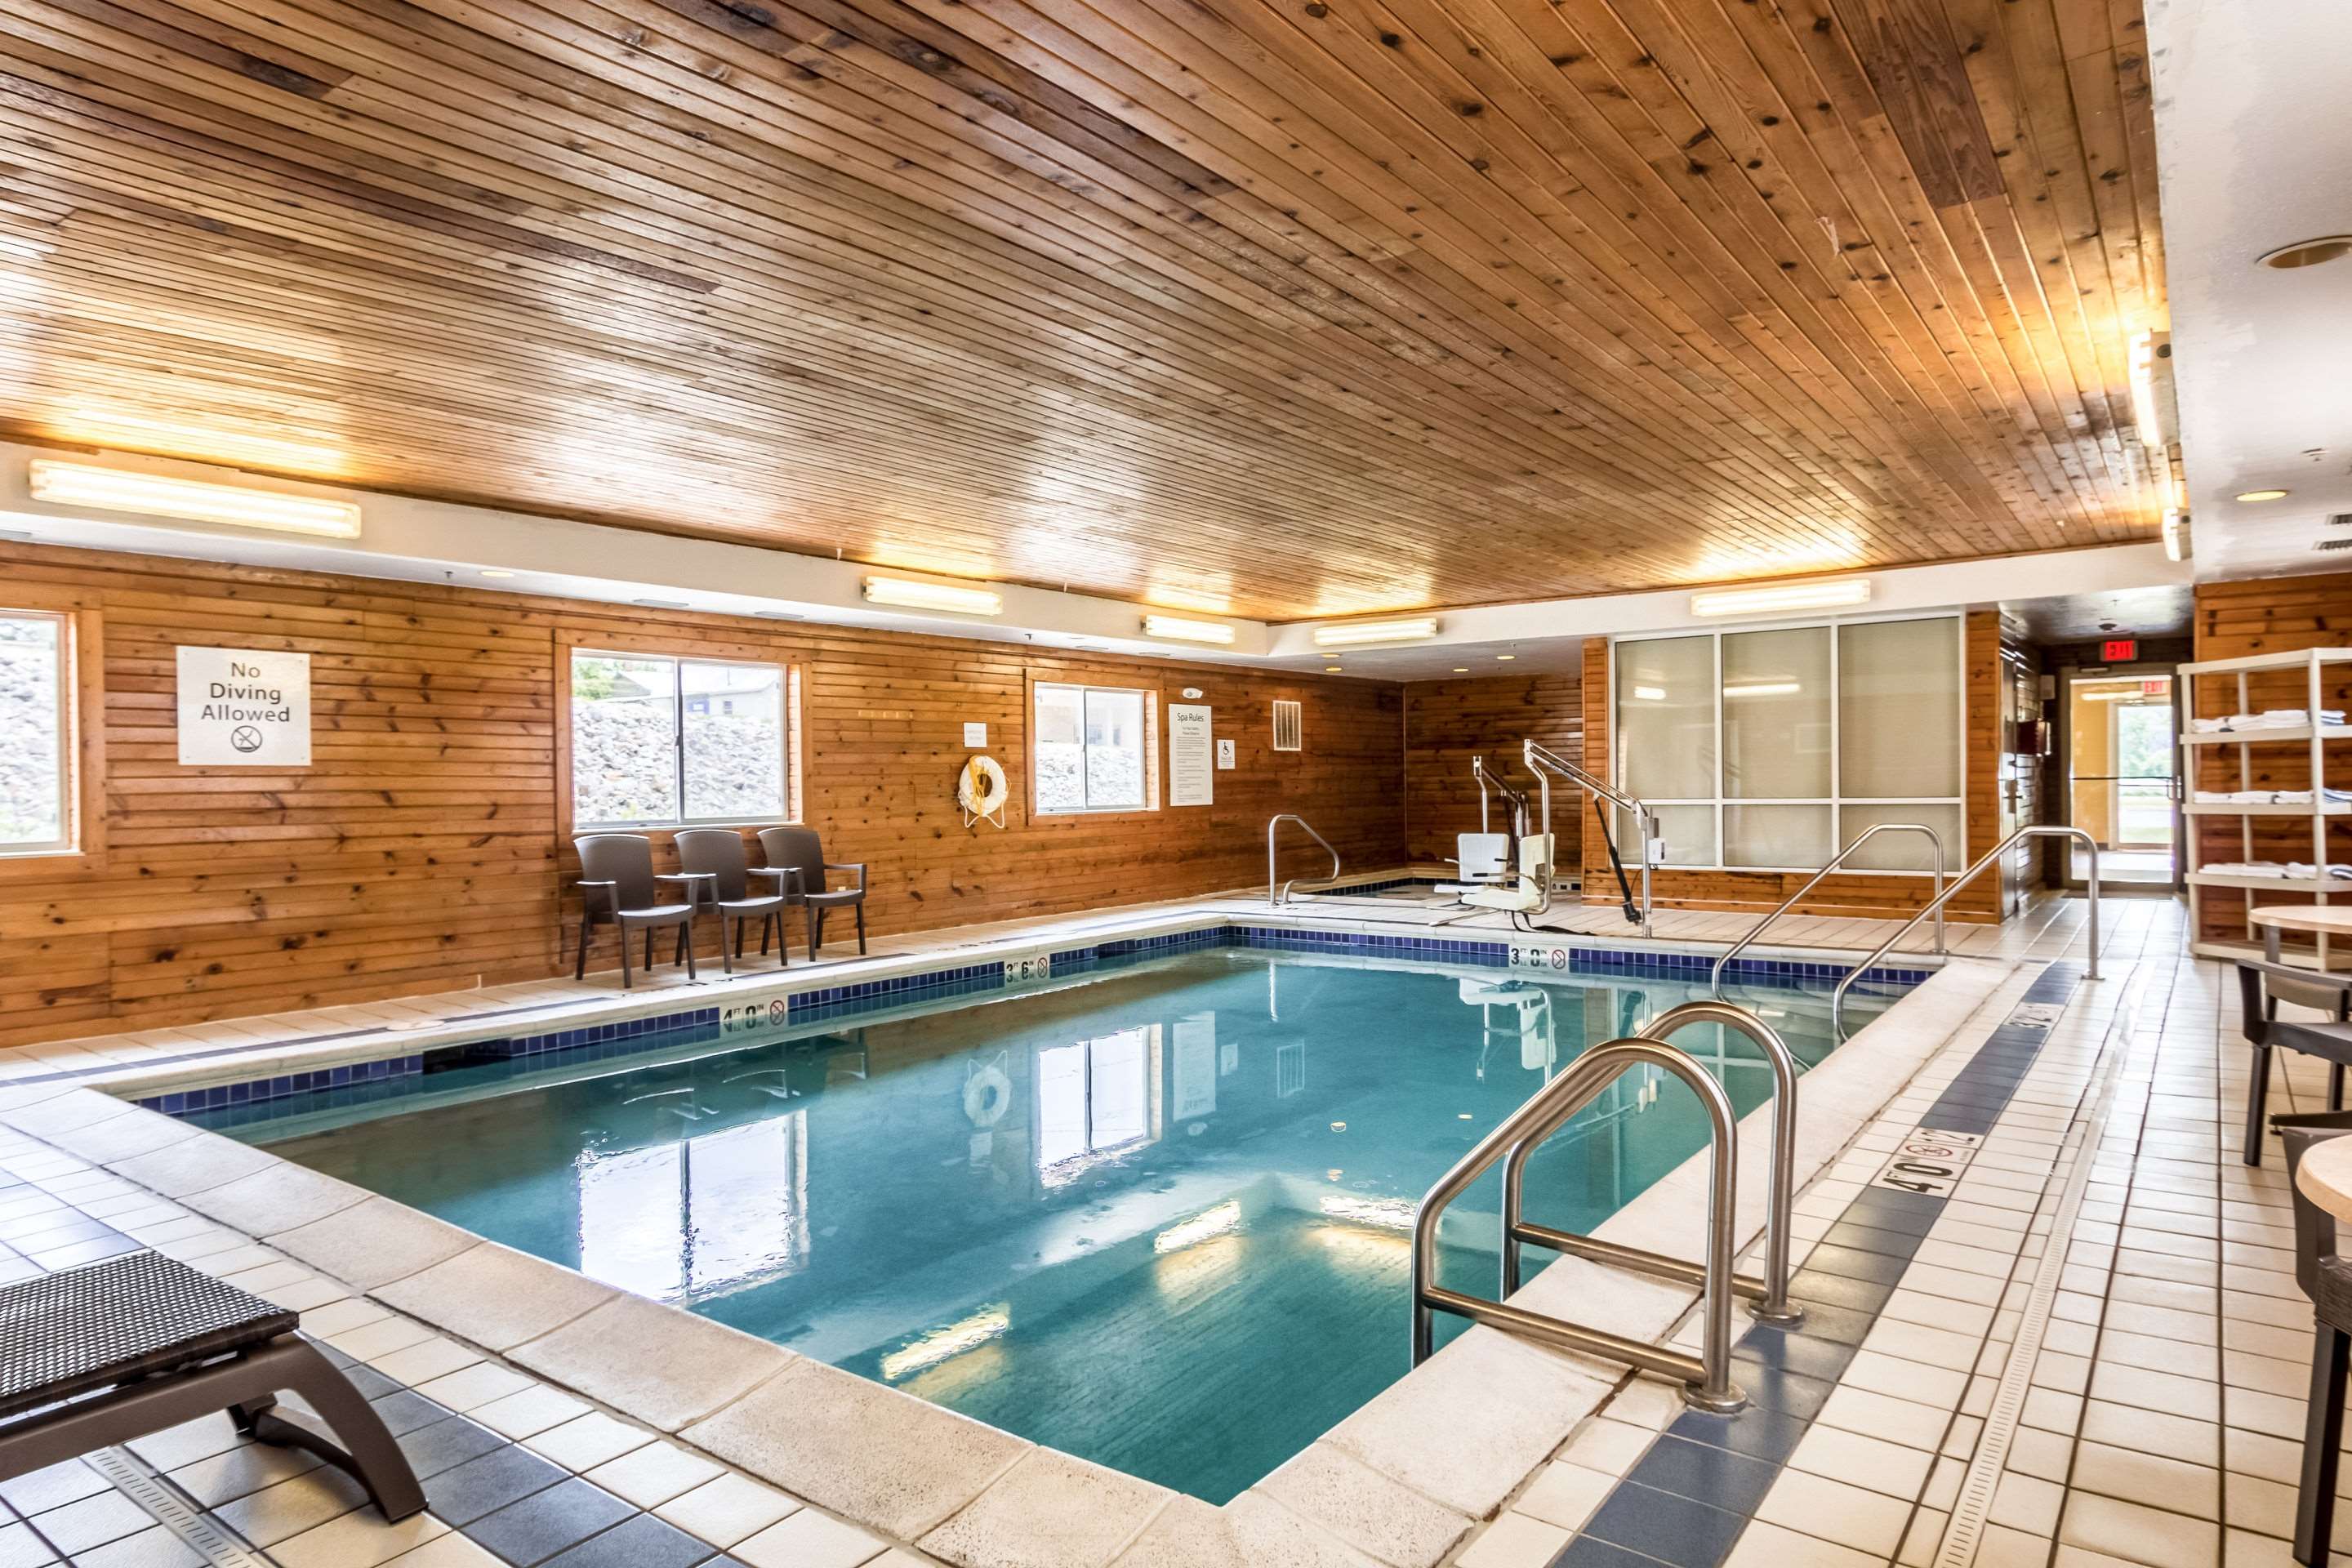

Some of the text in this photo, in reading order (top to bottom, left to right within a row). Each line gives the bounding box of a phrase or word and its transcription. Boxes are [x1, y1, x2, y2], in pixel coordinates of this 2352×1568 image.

[231, 662, 261, 679] No
[210, 683, 281, 705] Diving
[2144, 680, 2163, 693] EXIT
[201, 705, 290, 722] Allowed
[1177, 712, 1205, 724] Spa Rules
